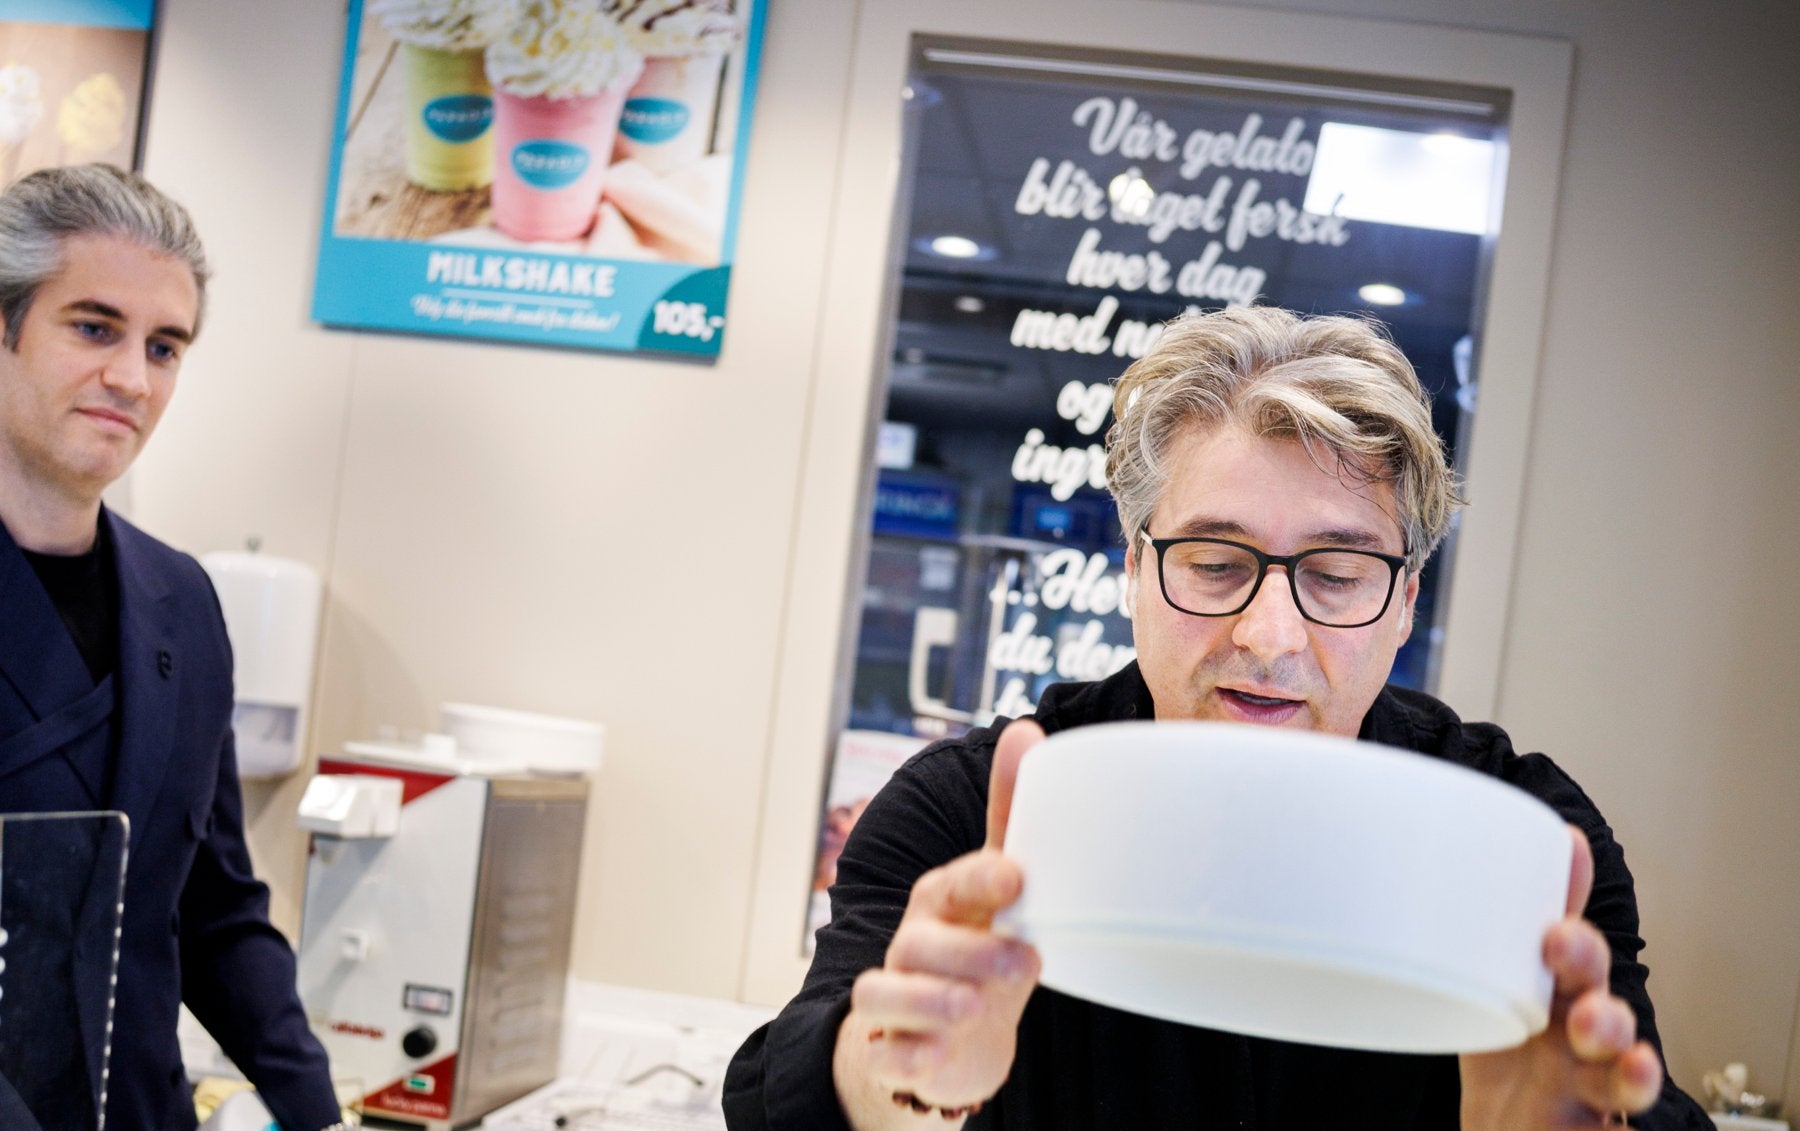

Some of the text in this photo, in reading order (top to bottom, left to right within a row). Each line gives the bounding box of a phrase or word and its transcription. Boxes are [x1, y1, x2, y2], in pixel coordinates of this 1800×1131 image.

[1072, 97, 1316, 180] Vår gelato
[1014, 157, 1108, 221] blir
[1226, 178, 1350, 251] fersk
[427, 252, 616, 298] MILKSHAKE
[1066, 227, 1267, 307] hver dag
[654, 300, 725, 342] 105,-
[1010, 295, 1119, 355] med
[1056, 380, 1114, 435] og
[990, 612, 1054, 676] du
